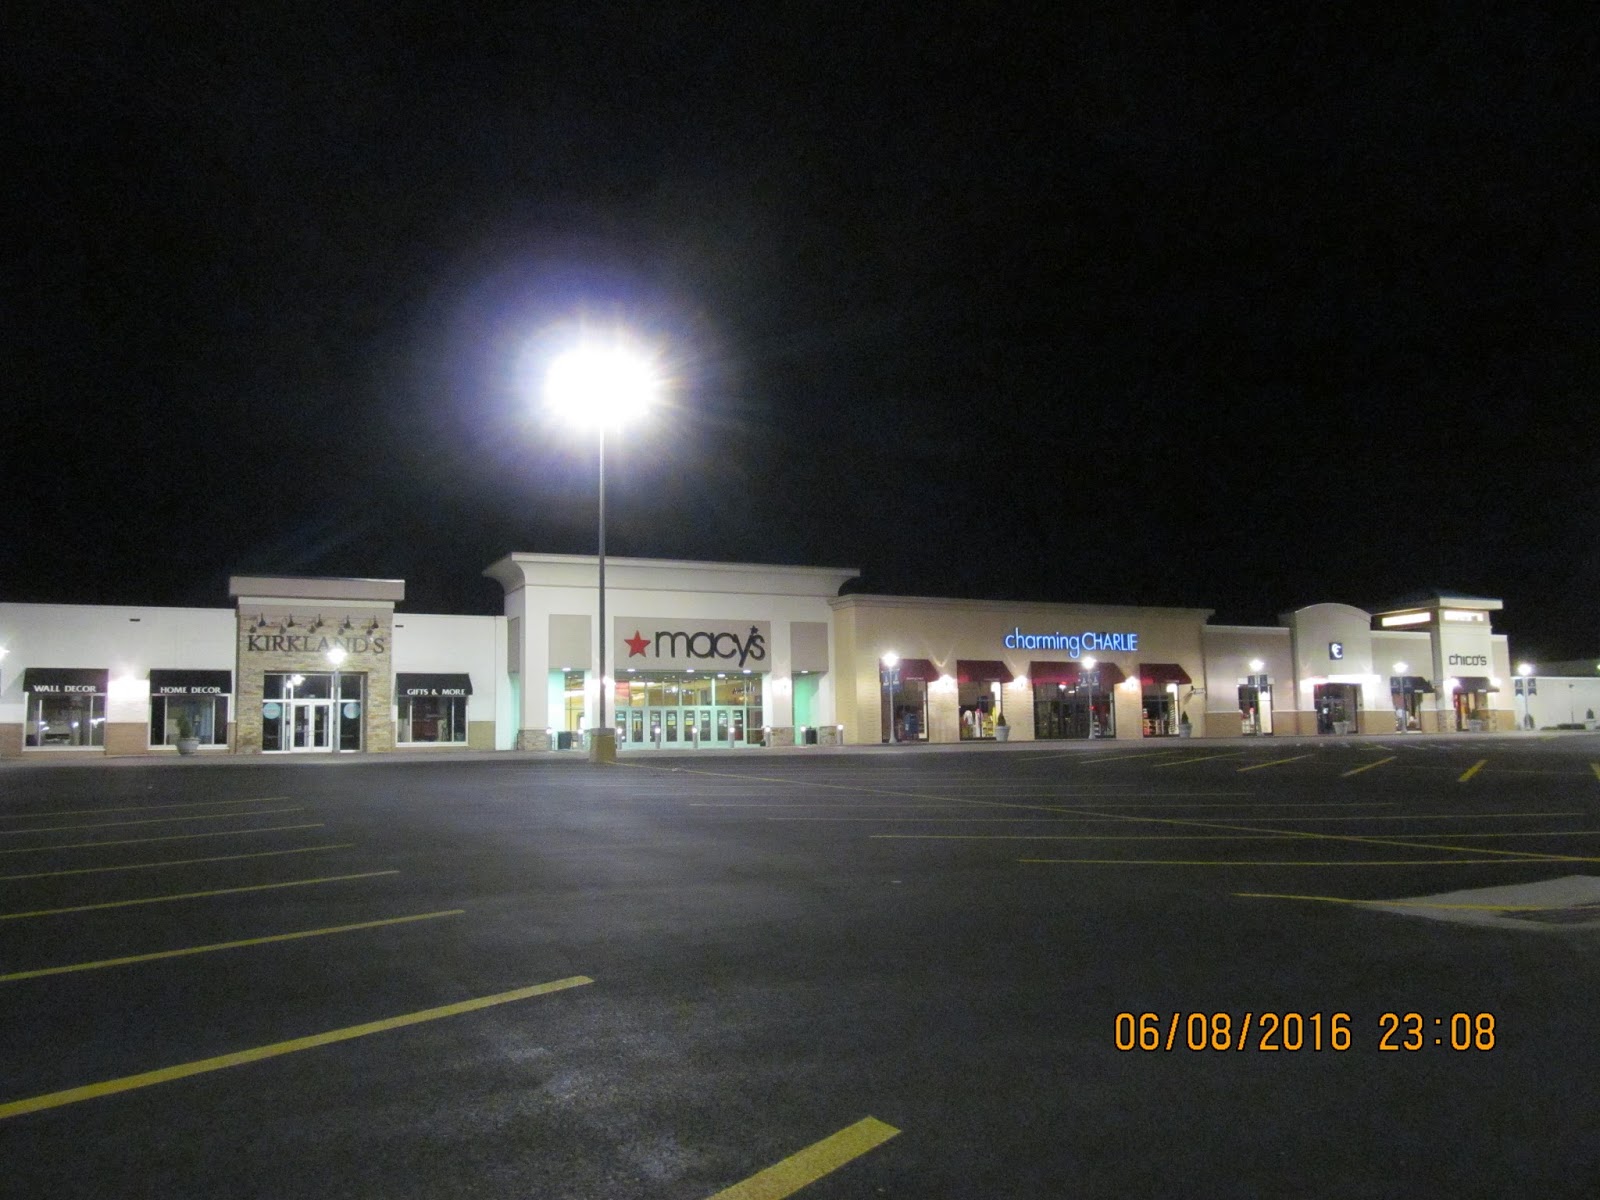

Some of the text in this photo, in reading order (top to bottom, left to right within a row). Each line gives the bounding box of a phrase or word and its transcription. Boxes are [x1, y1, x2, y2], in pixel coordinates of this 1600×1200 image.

[655, 625, 766, 668] macy's
[1005, 627, 1138, 659] charming CHARLIE
[33, 684, 97, 693] WALL DECOR
[160, 686, 222, 694] HOME DECOR
[407, 688, 466, 696] GIFTS & MORE
